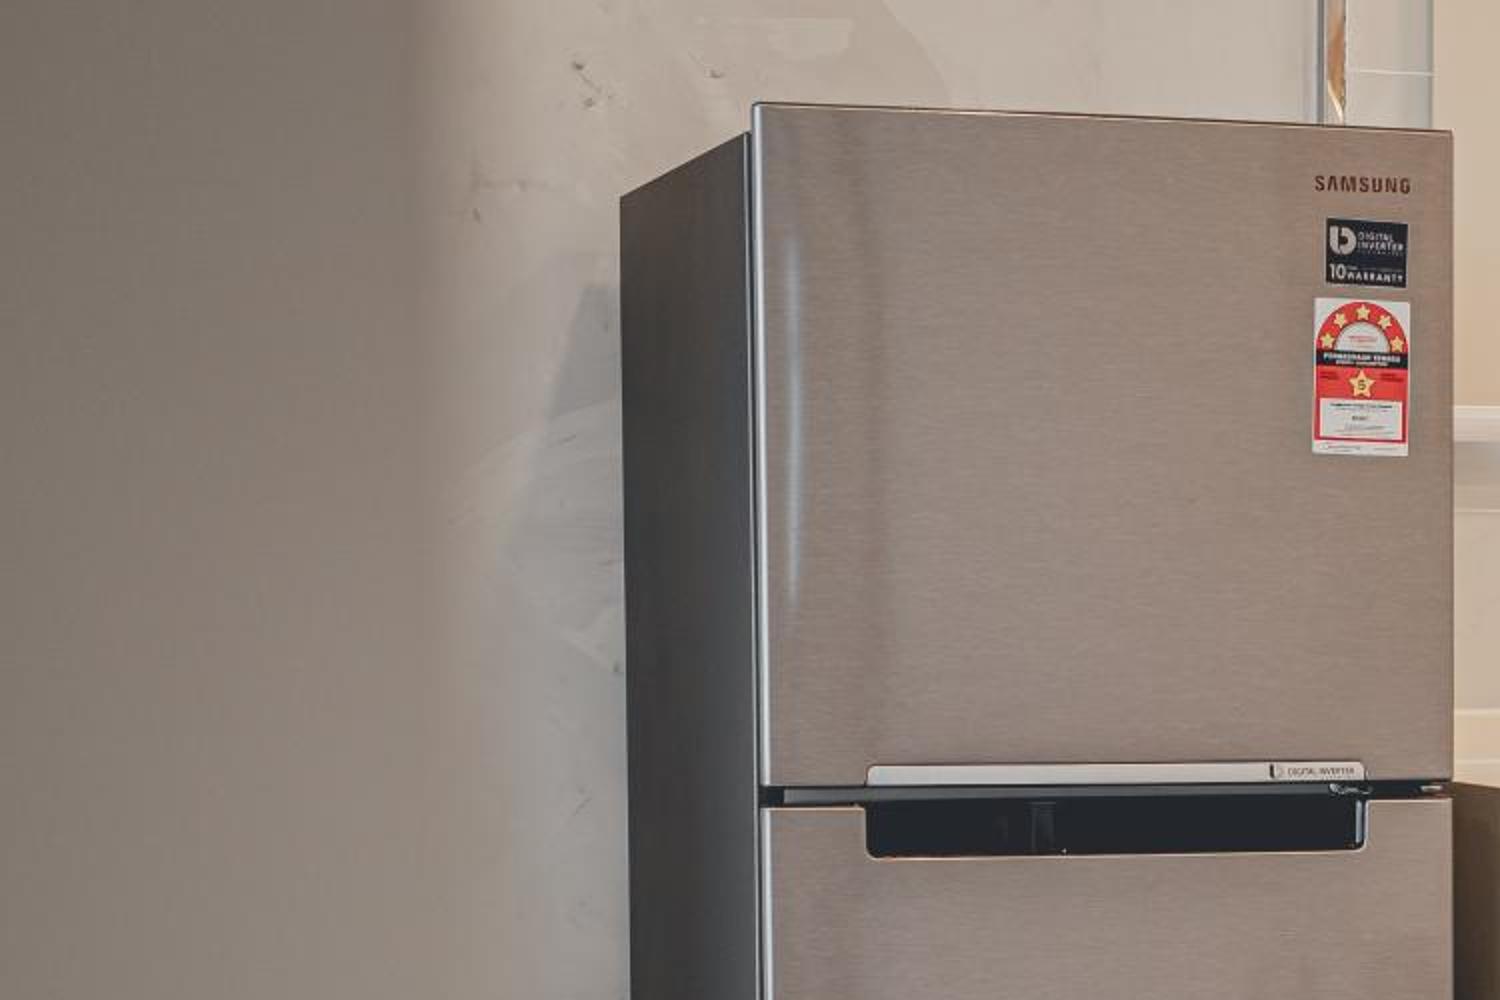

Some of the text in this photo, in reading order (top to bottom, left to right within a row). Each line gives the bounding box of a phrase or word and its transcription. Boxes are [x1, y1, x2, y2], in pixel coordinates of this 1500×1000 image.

[1314, 175, 1411, 194] SAMSUNG
[1357, 231, 1394, 242] DIGITAL
[1357, 241, 1404, 252] INVERTER
[1329, 263, 1347, 280] 10
[1346, 271, 1404, 283] WARRANTY
